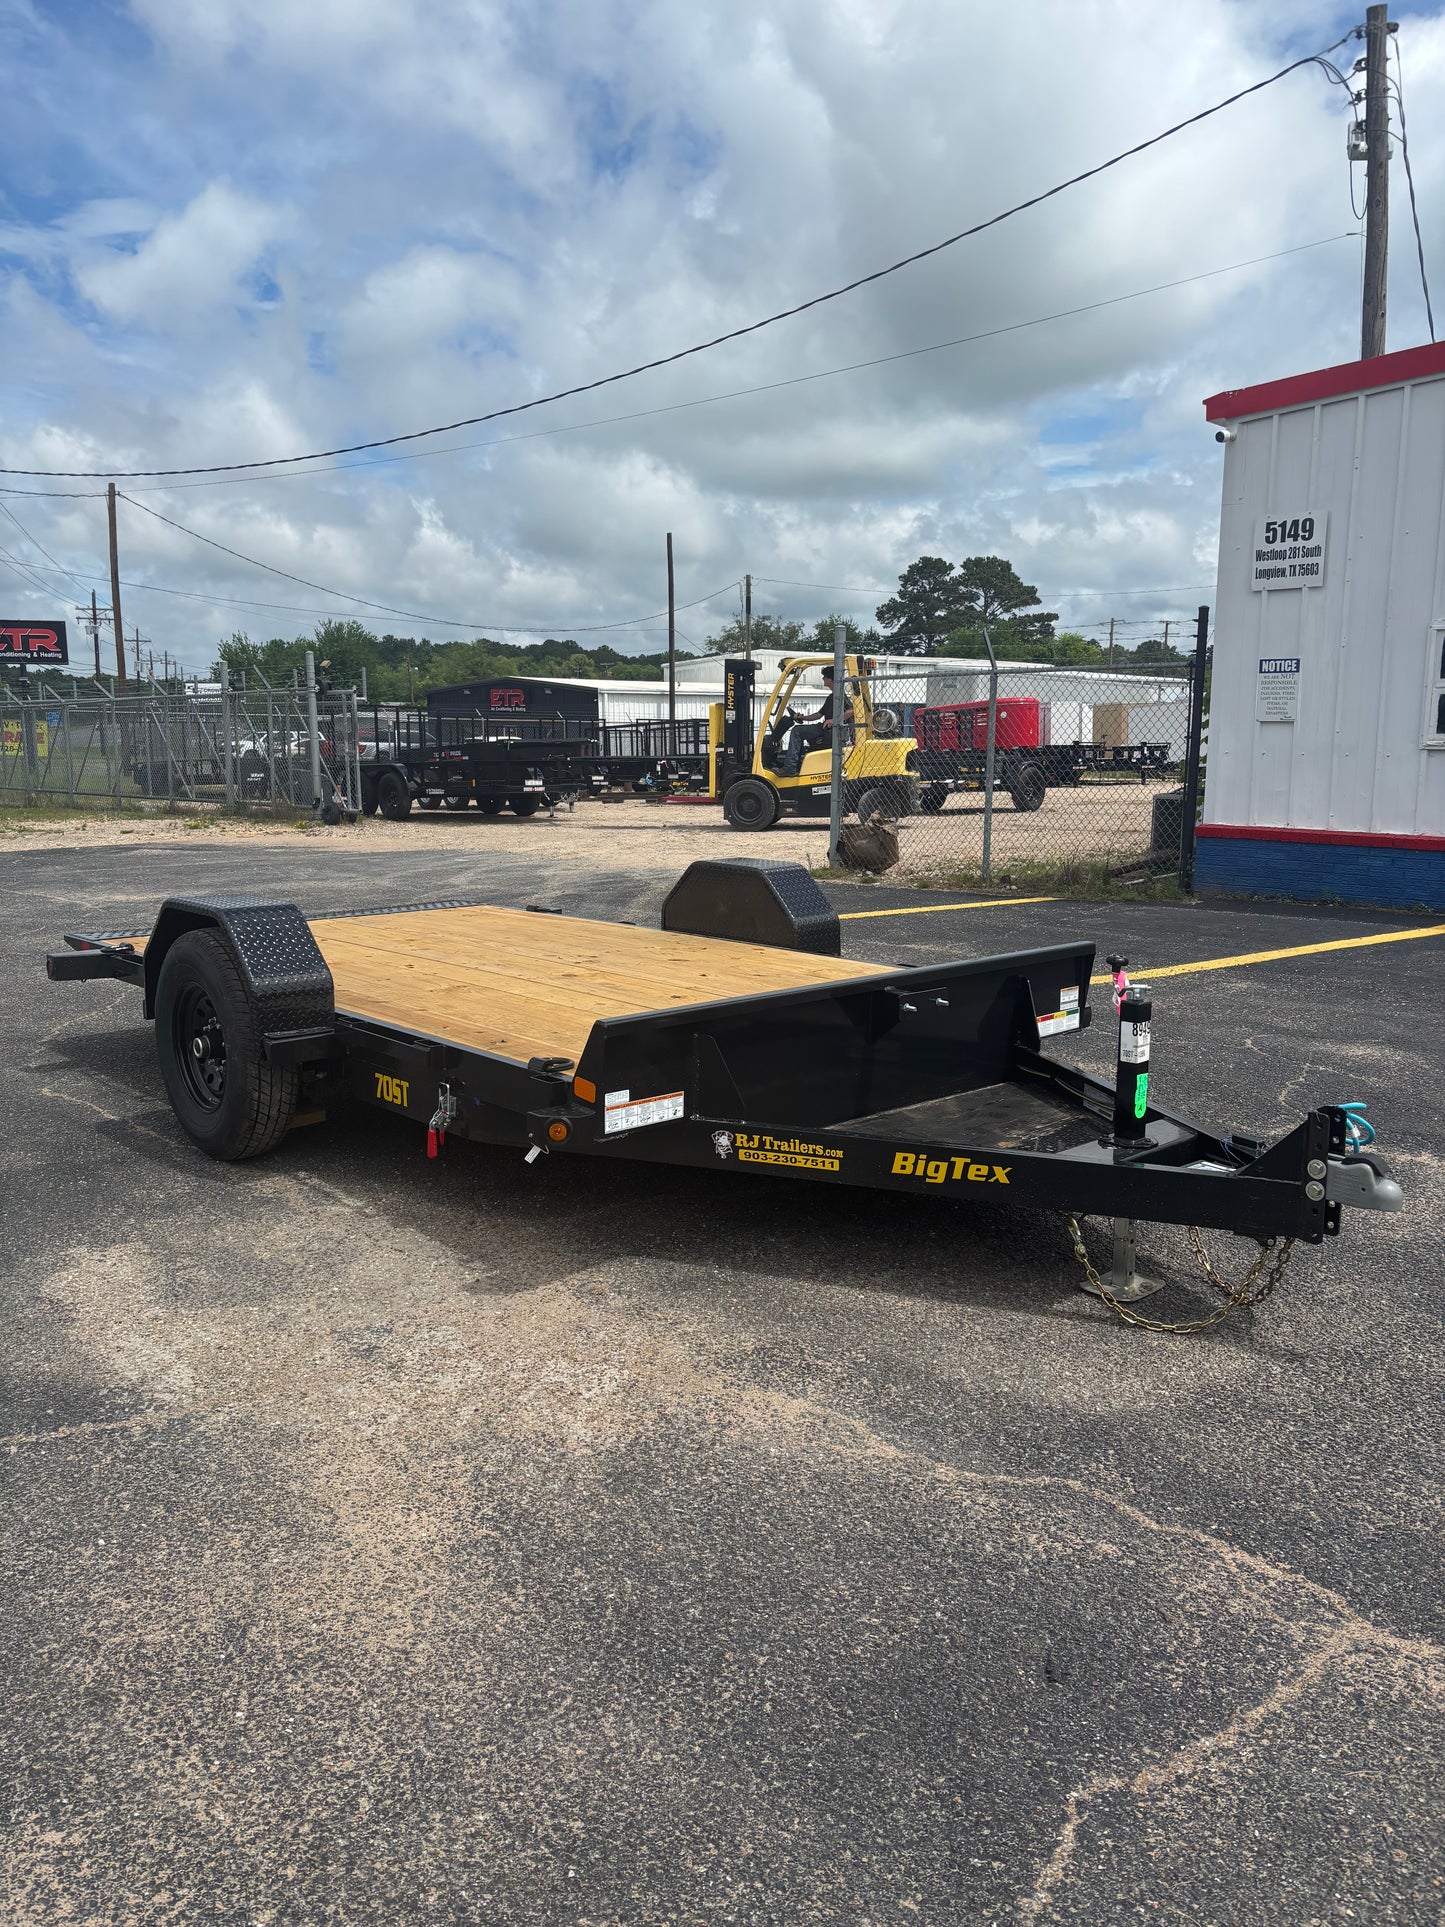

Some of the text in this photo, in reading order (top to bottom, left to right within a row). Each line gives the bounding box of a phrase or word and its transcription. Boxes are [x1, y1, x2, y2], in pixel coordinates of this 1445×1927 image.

[1264, 517, 1315, 545] 5149
[1255, 544, 1322, 562] Westloop 281 South
[1255, 562, 1320, 580] Longview, TX 75603
[40, 651, 62, 659] Heating
[1261, 660, 1298, 672] NOTICE
[490, 688, 526, 707] ETR
[727, 673, 735, 709] HYSTER
[374, 1072, 410, 1108] 70ST
[735, 1133, 760, 1149] RJ
[743, 1151, 836, 1169] 903-230-7511
[891, 1152, 1013, 1184] BigTex
